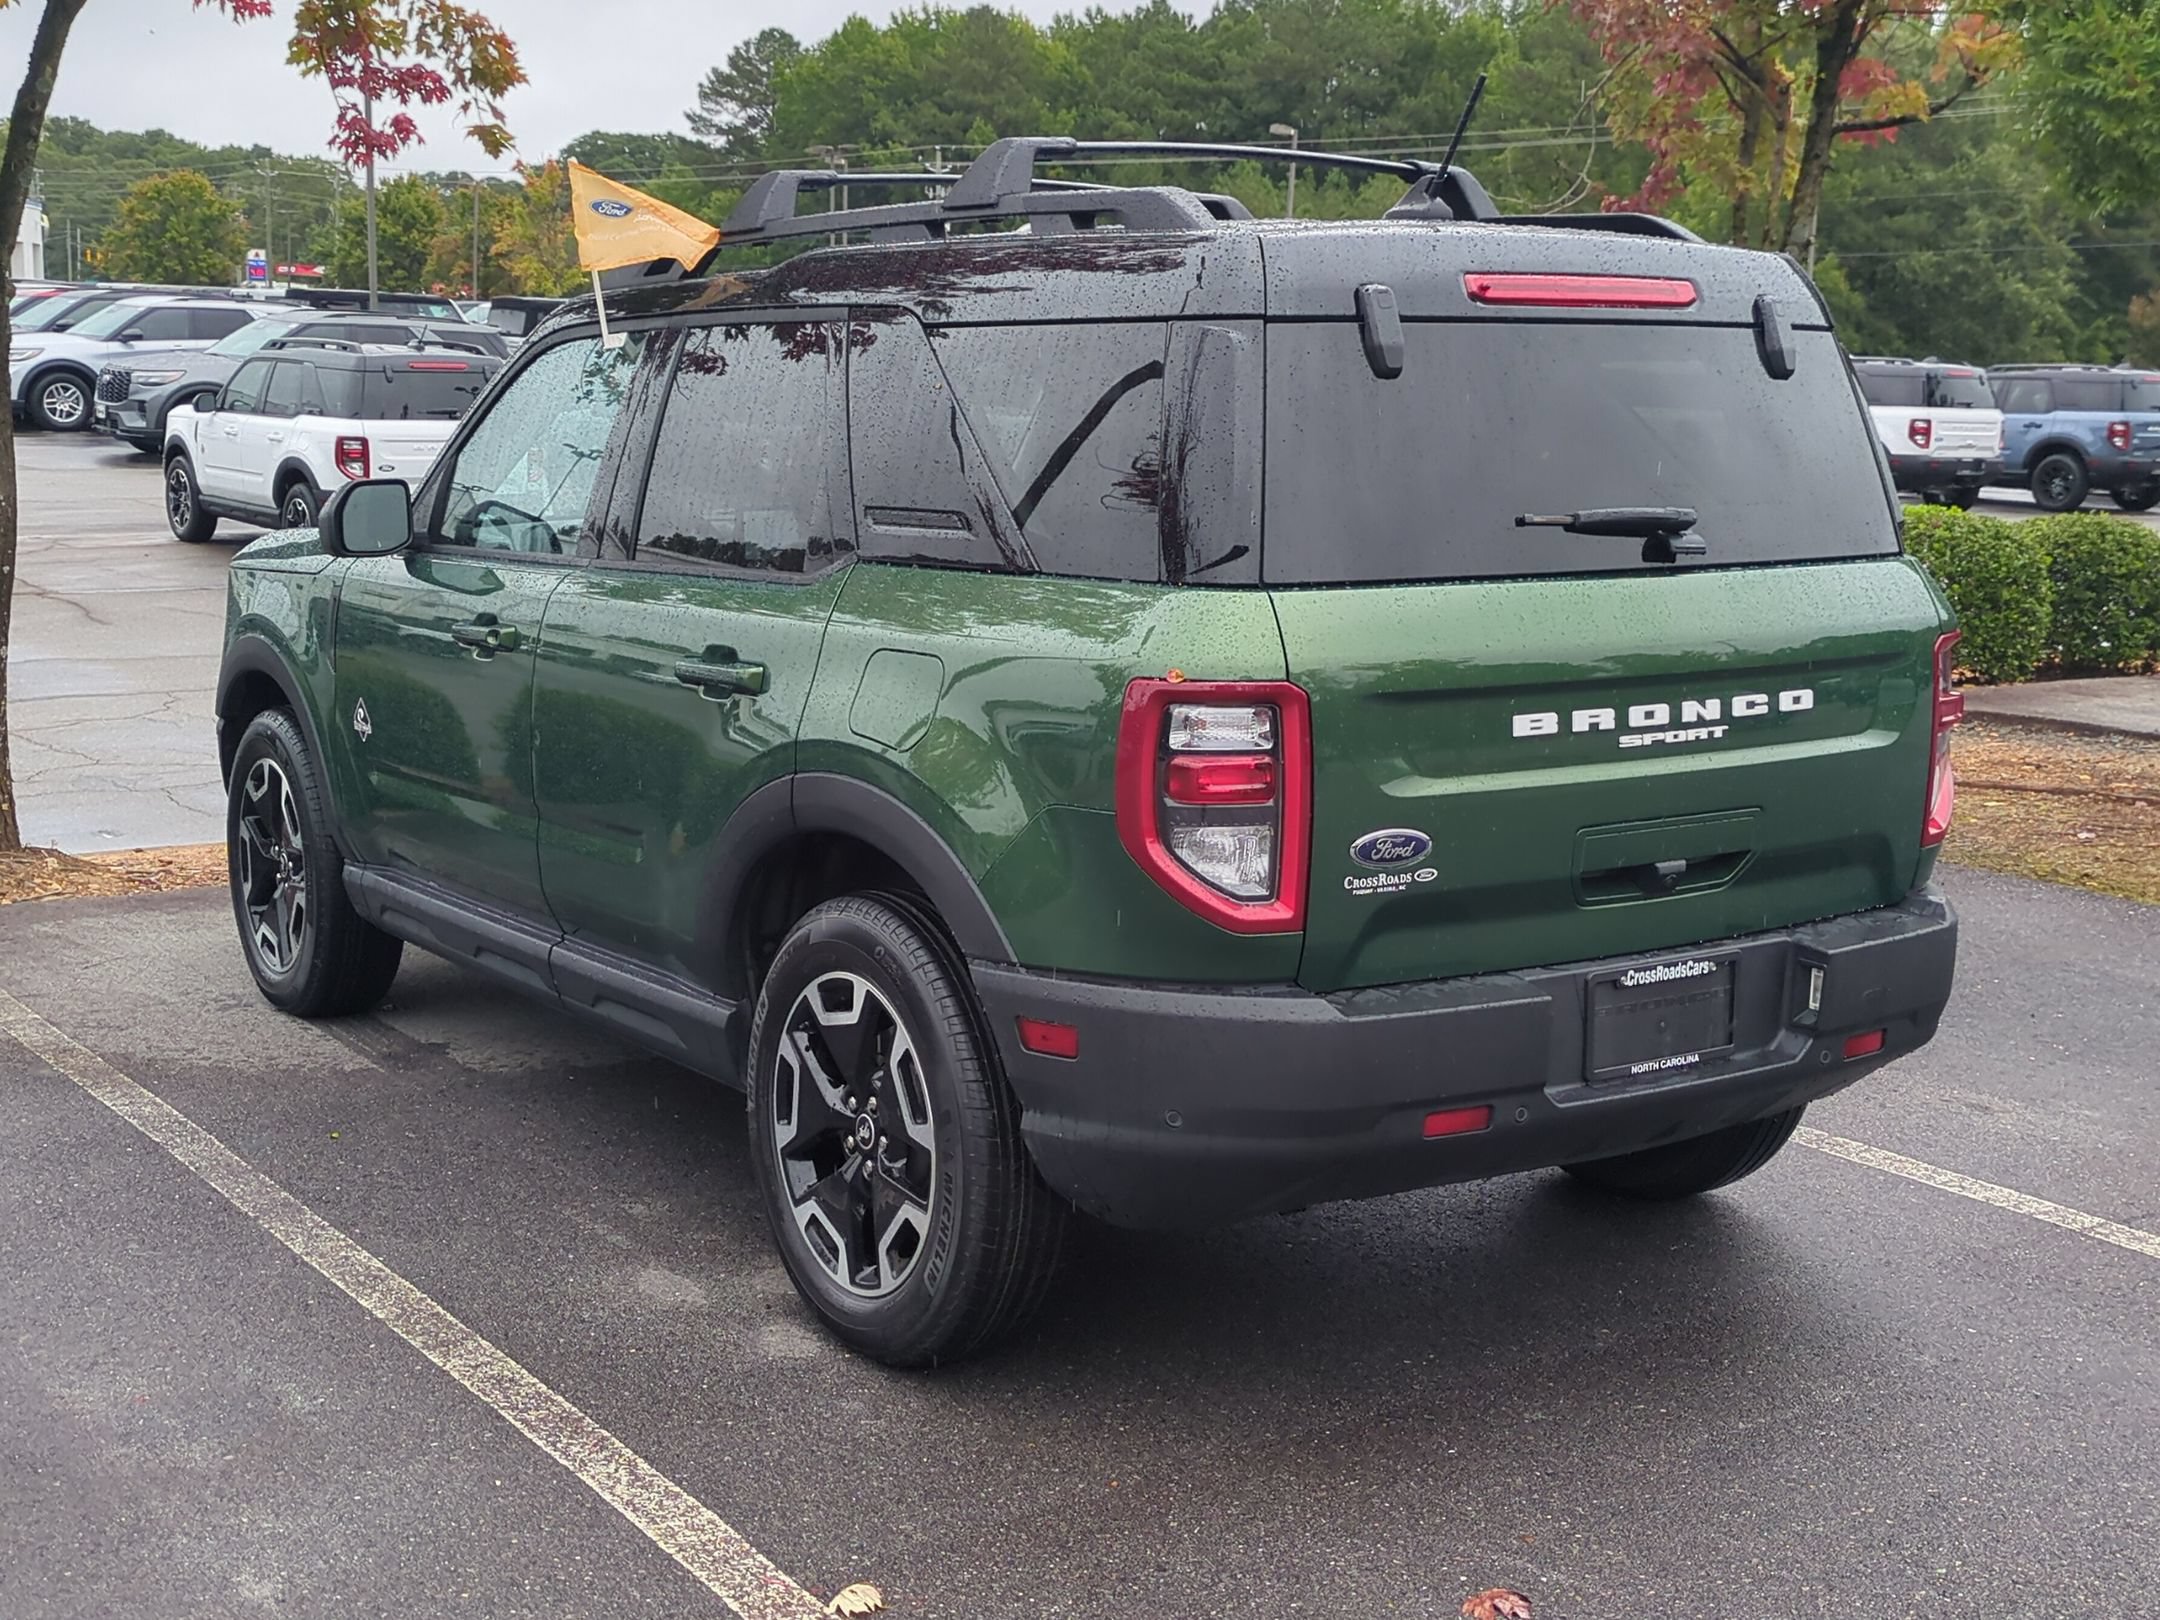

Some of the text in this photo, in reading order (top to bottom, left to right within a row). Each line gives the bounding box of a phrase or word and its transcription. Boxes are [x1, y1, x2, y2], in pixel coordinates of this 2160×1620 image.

[598, 201, 627, 217] Ford
[1511, 688, 1815, 738] BRONCO
[1618, 725, 1729, 749] SPORT
[1371, 837, 1417, 860] Ford
[1626, 960, 1710, 987] CrossRoadsCars
[1631, 1053, 1700, 1075] NORTH CAROLINA
[926, 1170, 954, 1289] MICHELIN
